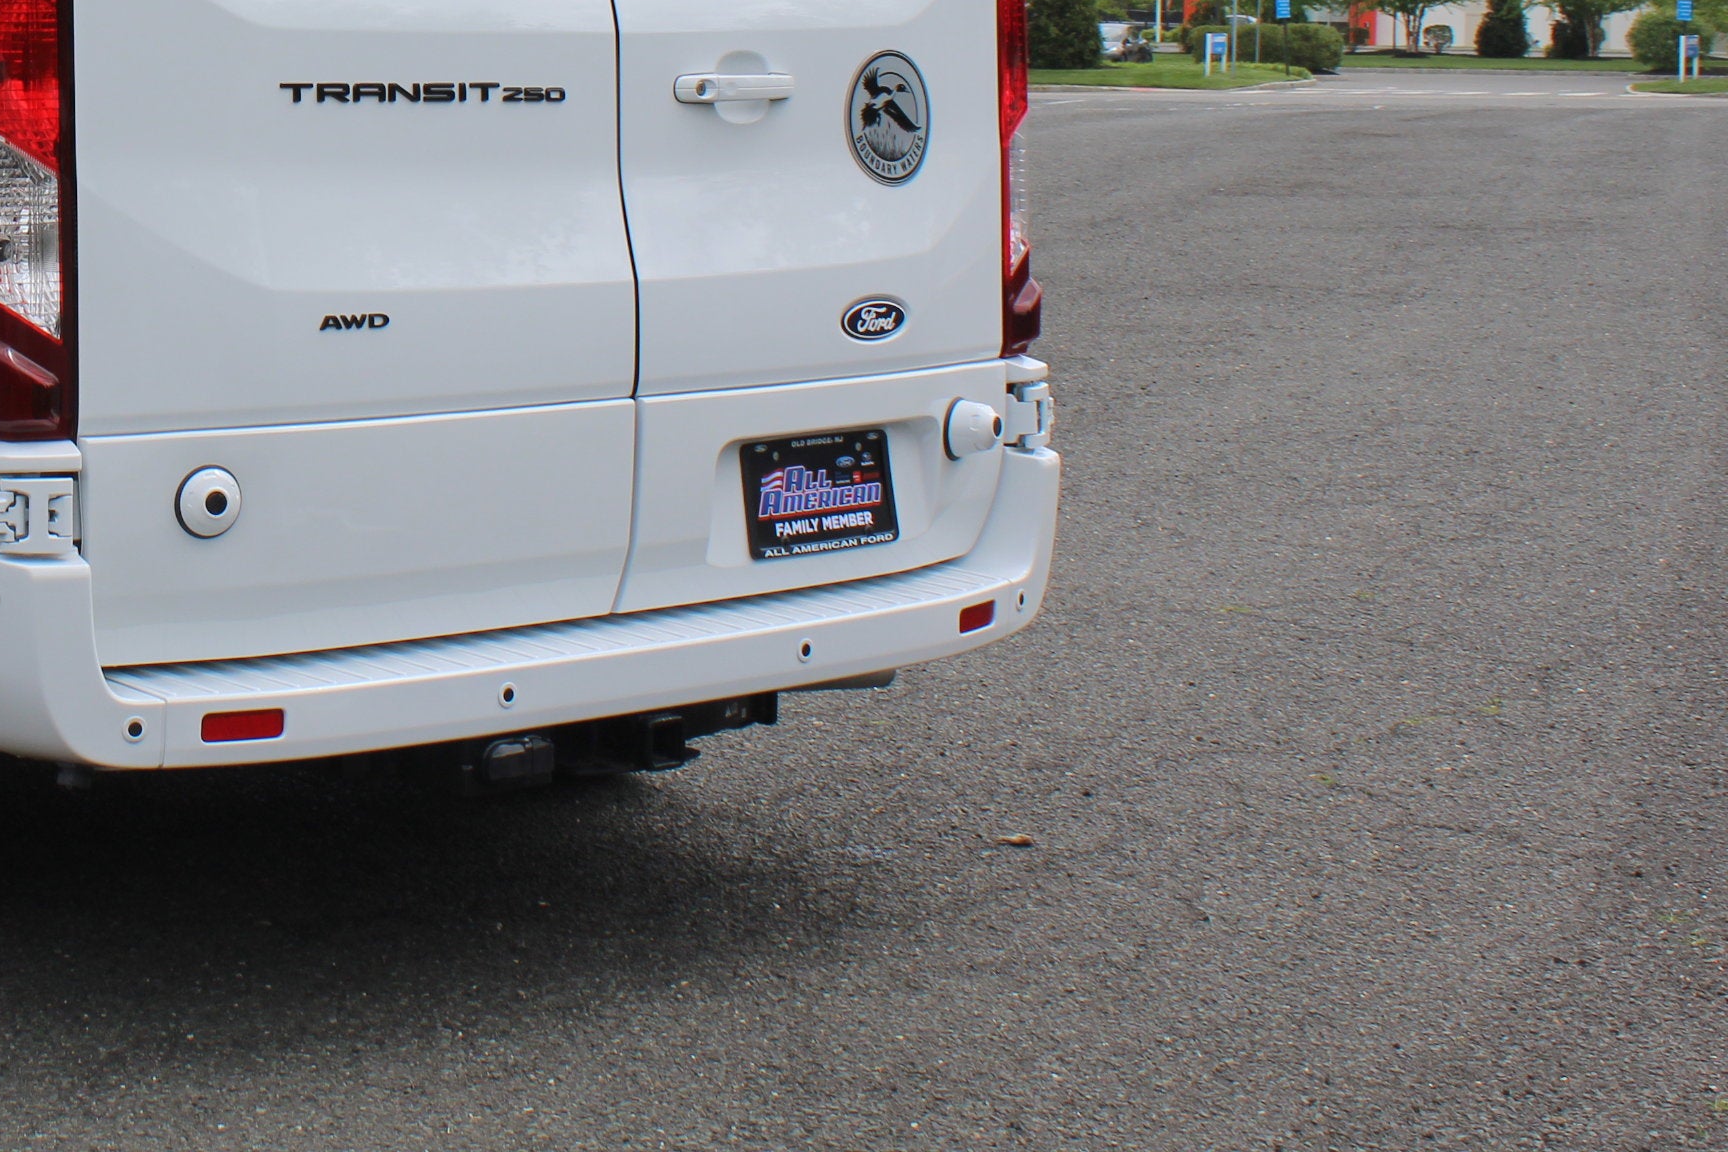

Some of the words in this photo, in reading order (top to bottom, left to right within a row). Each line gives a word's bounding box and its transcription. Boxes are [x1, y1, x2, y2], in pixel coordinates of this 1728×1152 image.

[279, 81, 501, 104] TRANSIT
[501, 86, 567, 103] 250
[855, 134, 898, 176] BOUNDARY
[899, 134, 925, 173] WATERS
[319, 312, 391, 332] AWD
[856, 306, 897, 333] Ford
[775, 517, 820, 538] FAMILY
[822, 510, 874, 532] MEMBER
[764, 548, 791, 559] ALL
[791, 538, 859, 555] AMERICAN
[860, 533, 895, 545] FORD
